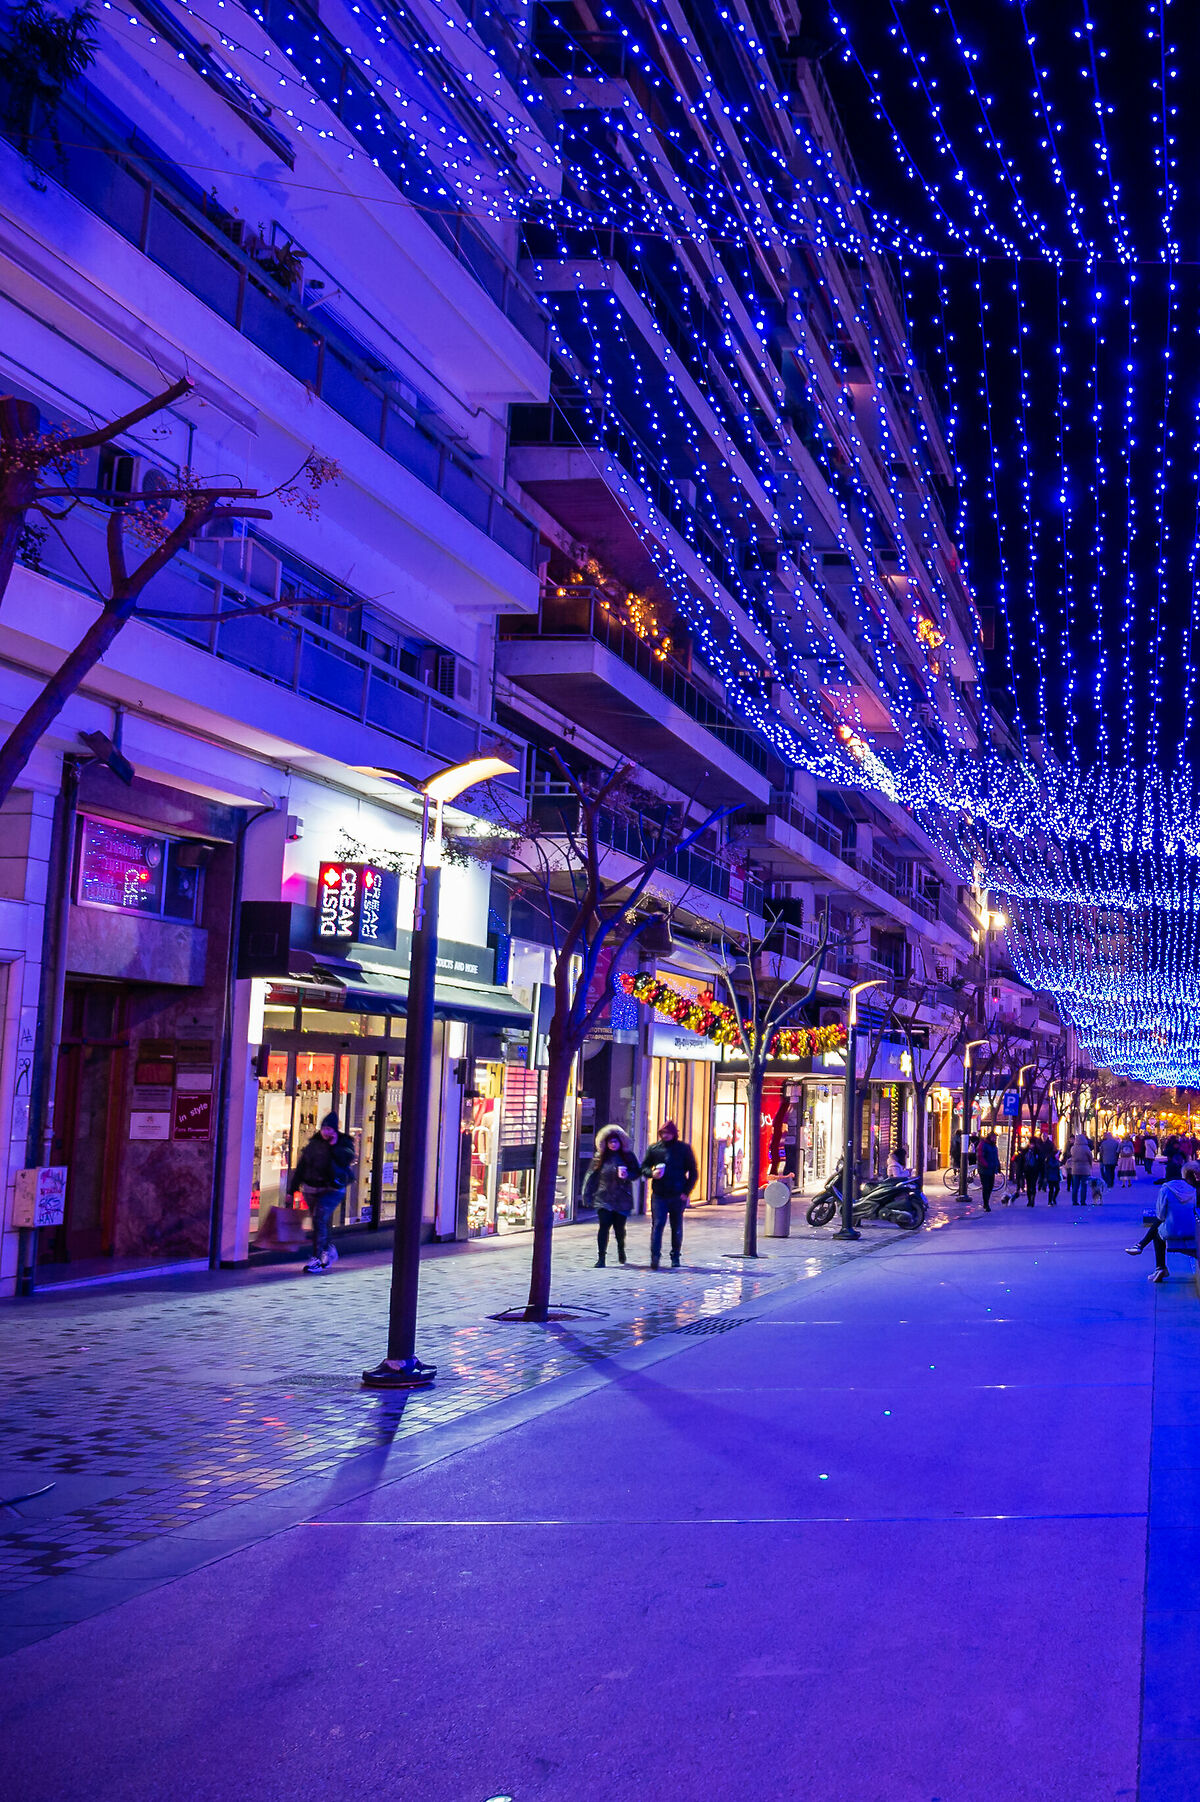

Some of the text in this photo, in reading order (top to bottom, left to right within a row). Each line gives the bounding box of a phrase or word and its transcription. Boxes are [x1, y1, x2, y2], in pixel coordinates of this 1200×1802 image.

[320, 884, 340, 936] DUST
[337, 868, 358, 937] CREAM
[369, 874, 383, 939] CREAM
[465, 963, 479, 975] MORE
[1007, 1096, 1017, 1107] P
